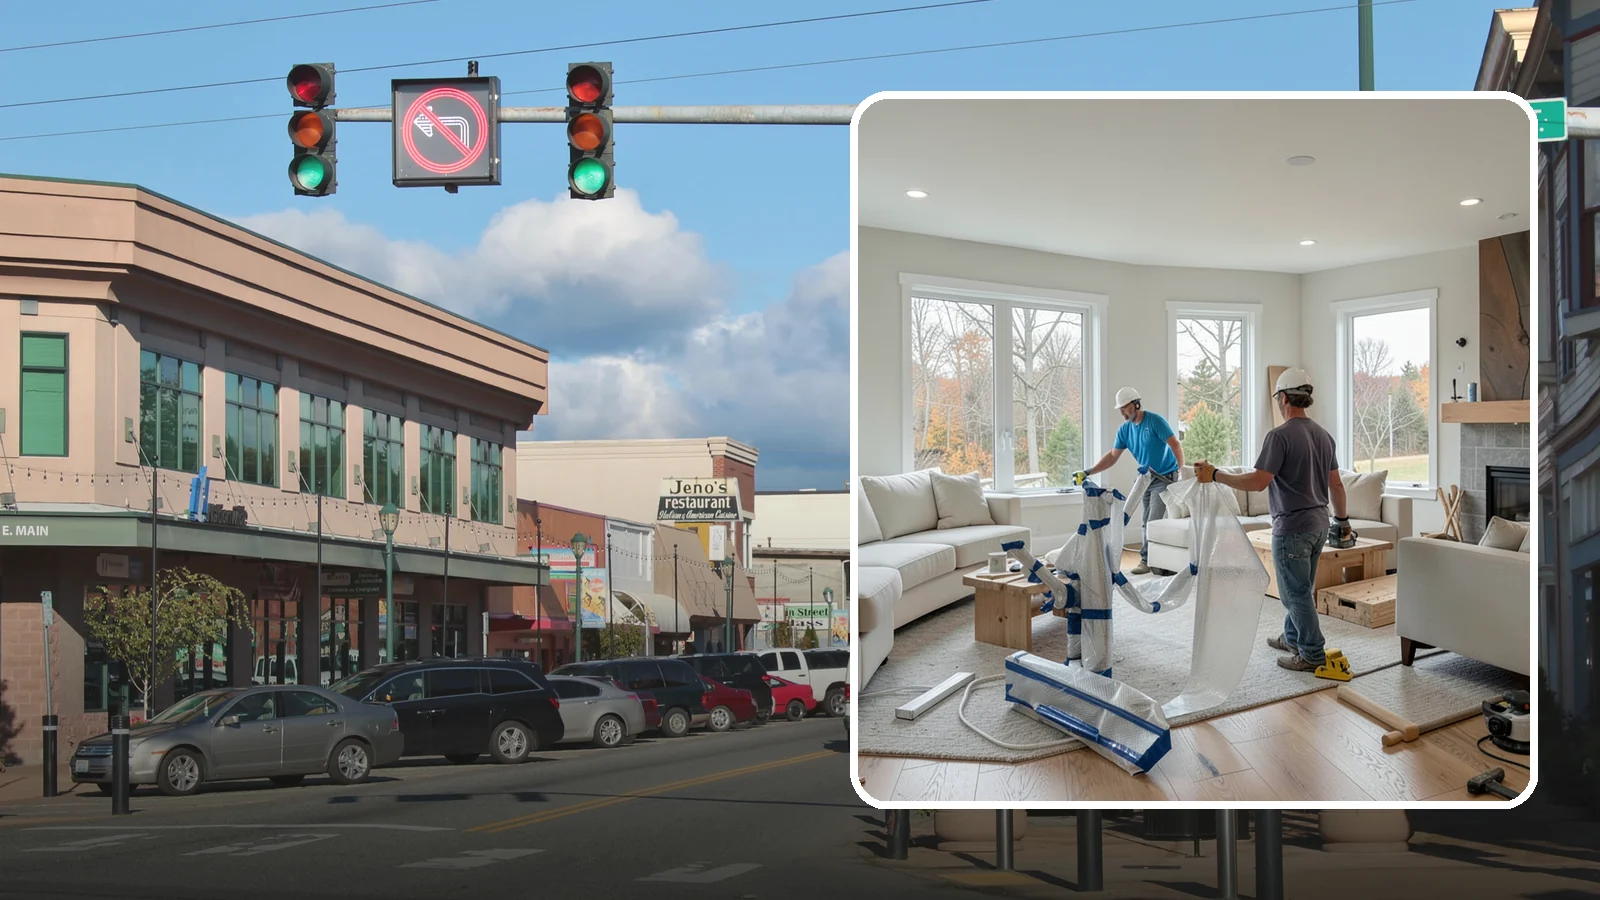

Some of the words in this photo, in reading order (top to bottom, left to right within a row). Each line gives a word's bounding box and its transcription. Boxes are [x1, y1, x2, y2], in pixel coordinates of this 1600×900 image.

[669, 480, 727, 494] Jeno's
[665, 496, 731, 509] restaurant
[658, 510, 681, 520] Italian
[686, 510, 714, 520] American
[714, 510, 738, 519] Cuisine
[2, 525, 12, 536] E.
[15, 525, 49, 536] MAIN
[798, 608, 828, 616] Street
